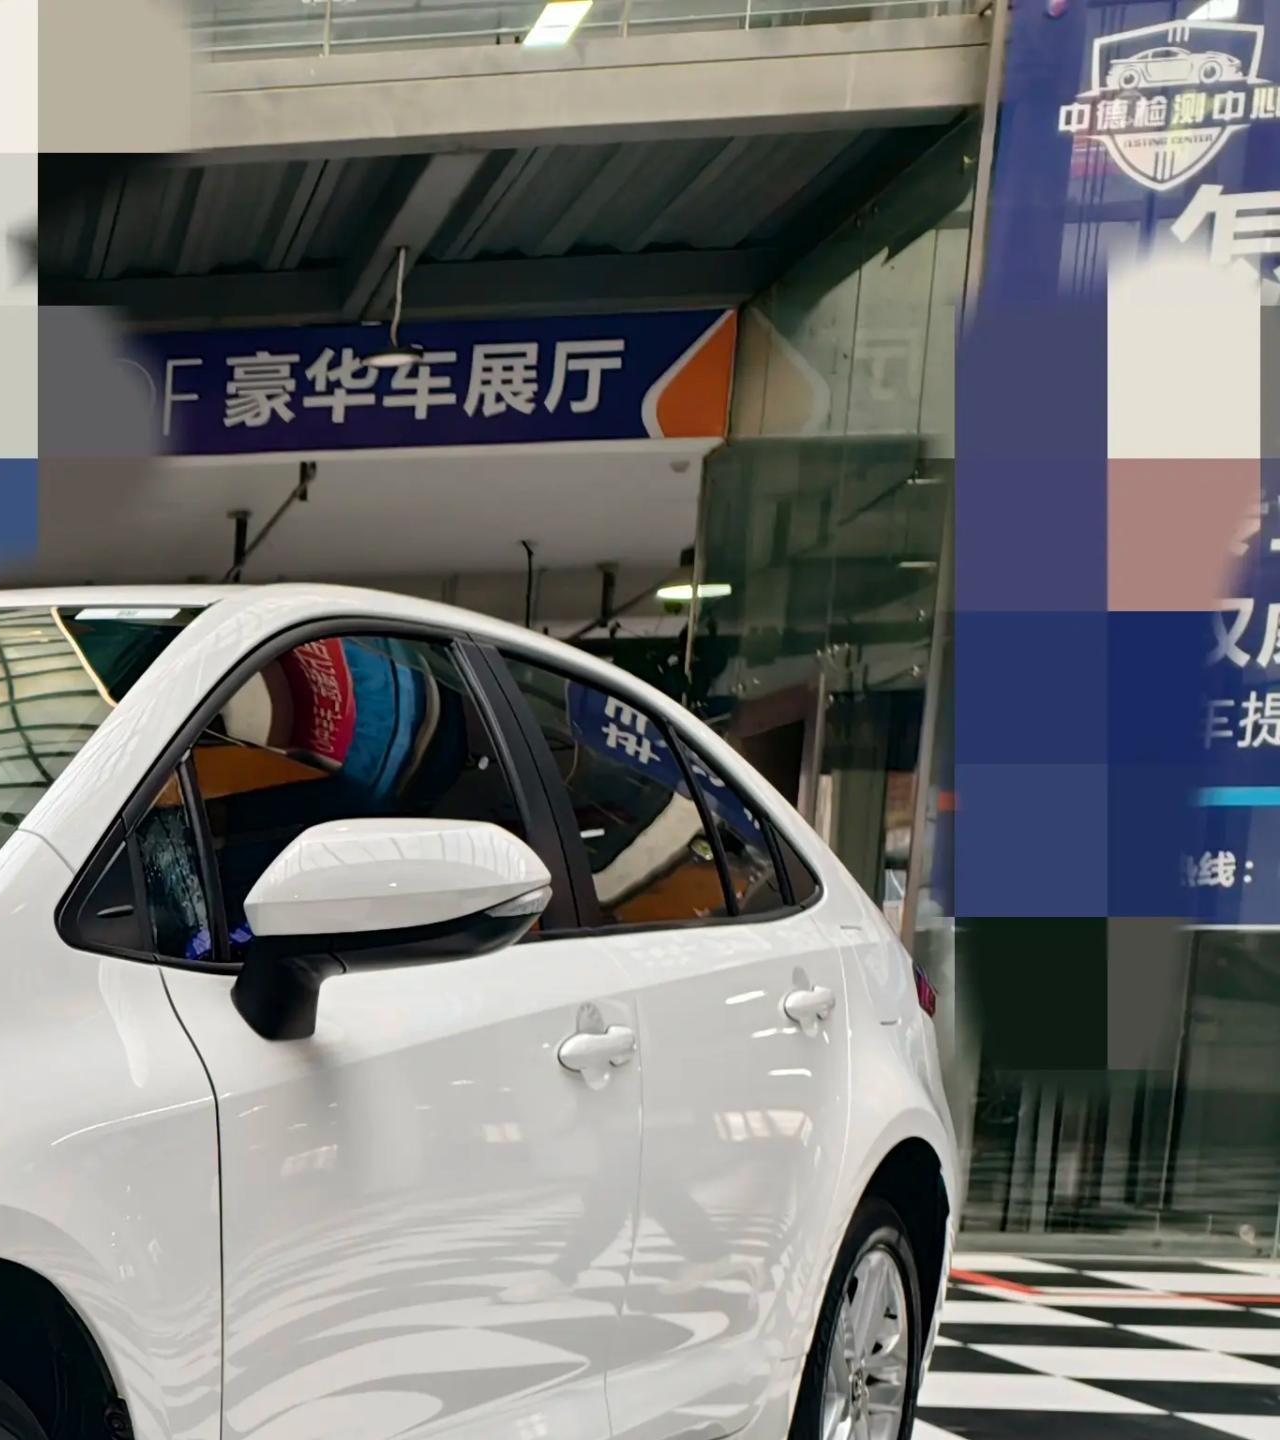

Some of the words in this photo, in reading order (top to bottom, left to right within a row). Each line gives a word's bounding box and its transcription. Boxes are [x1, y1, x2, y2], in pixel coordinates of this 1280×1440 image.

[1058, 87, 1280, 133] 中德检测中心
[223, 338, 626, 429] 豪华车展厅
